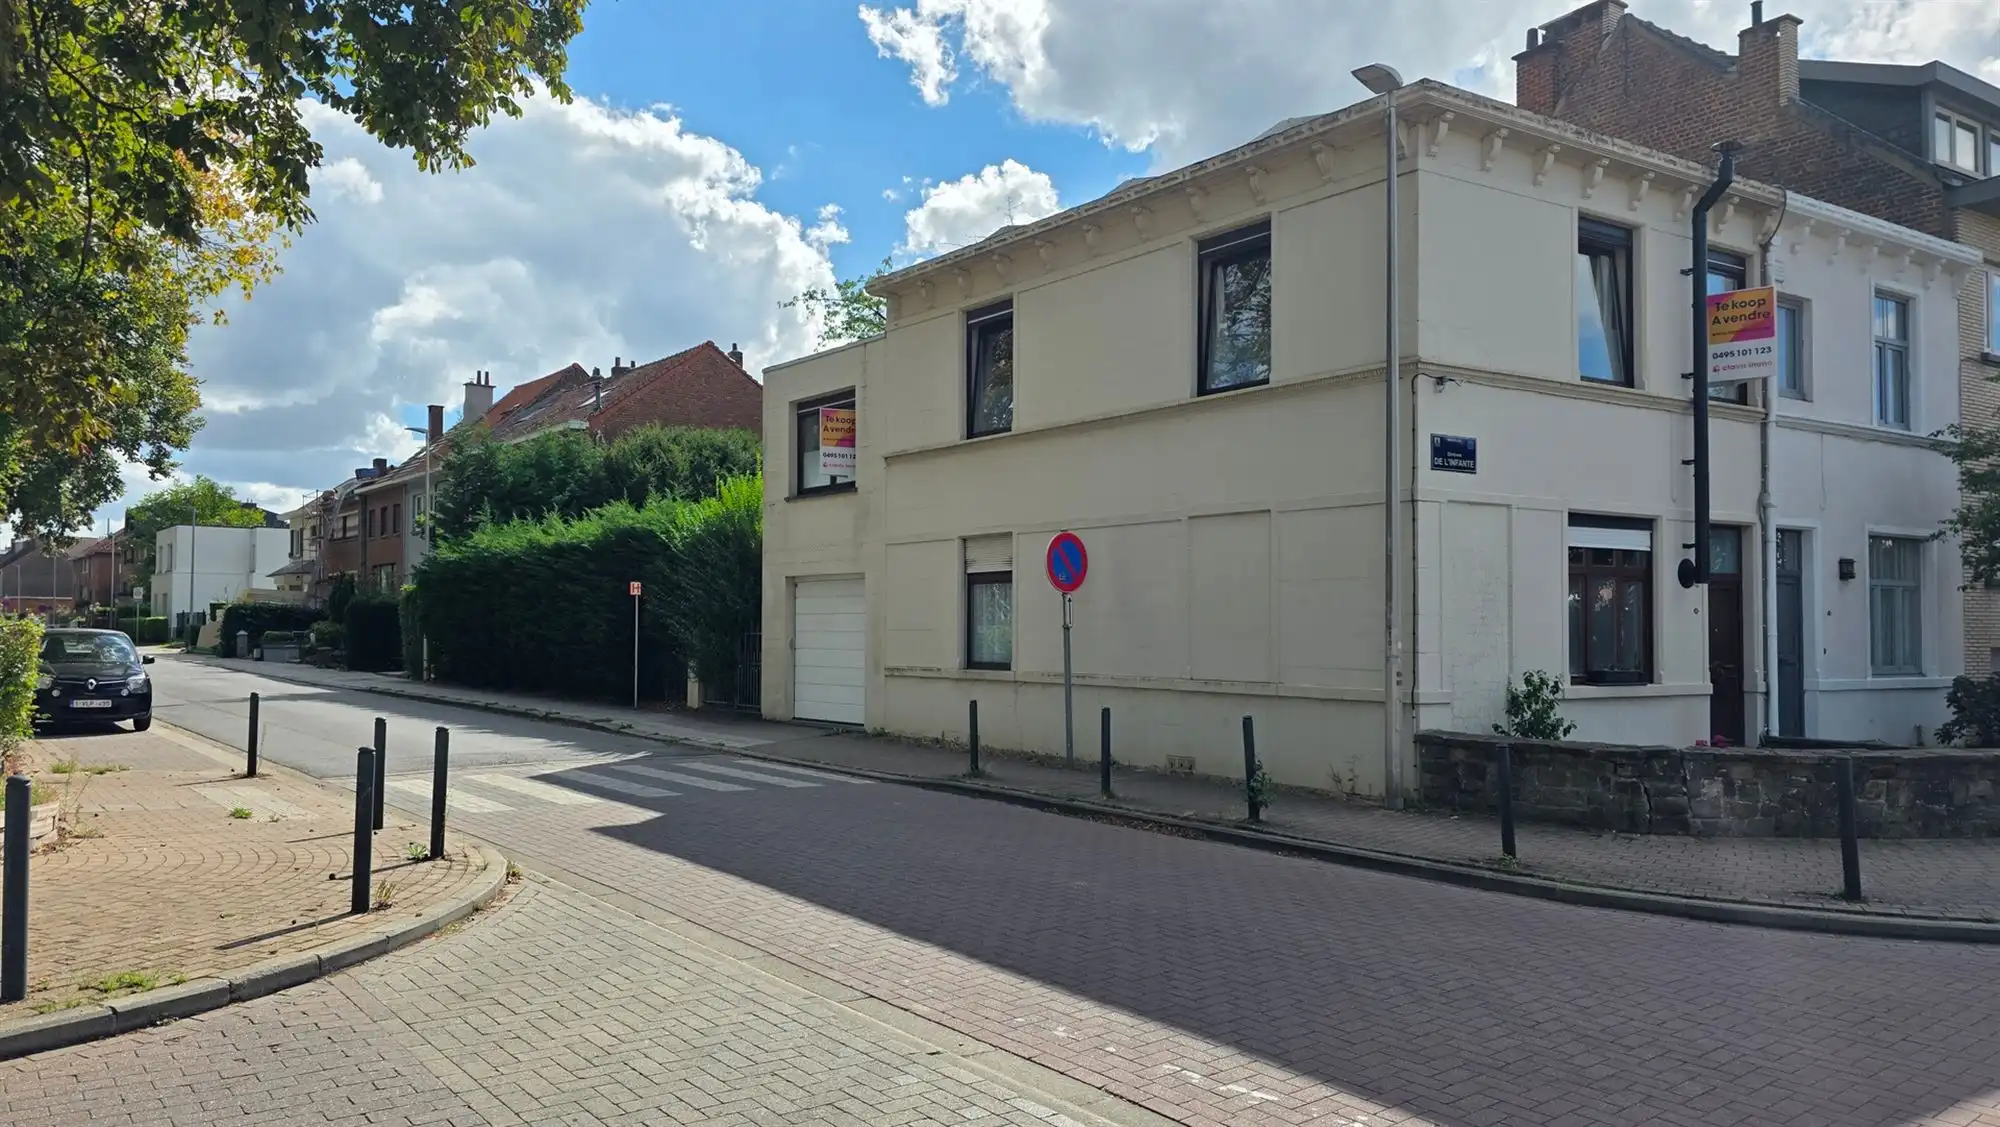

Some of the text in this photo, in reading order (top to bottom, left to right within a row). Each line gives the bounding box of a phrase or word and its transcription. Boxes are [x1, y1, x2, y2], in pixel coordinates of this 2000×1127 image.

[1716, 298, 1766, 312] Te koop
[1712, 310, 1771, 326] A vendre
[1712, 345, 1773, 360] 0495 101 123
[1434, 456, 1475, 469] DE L'INFANTE
